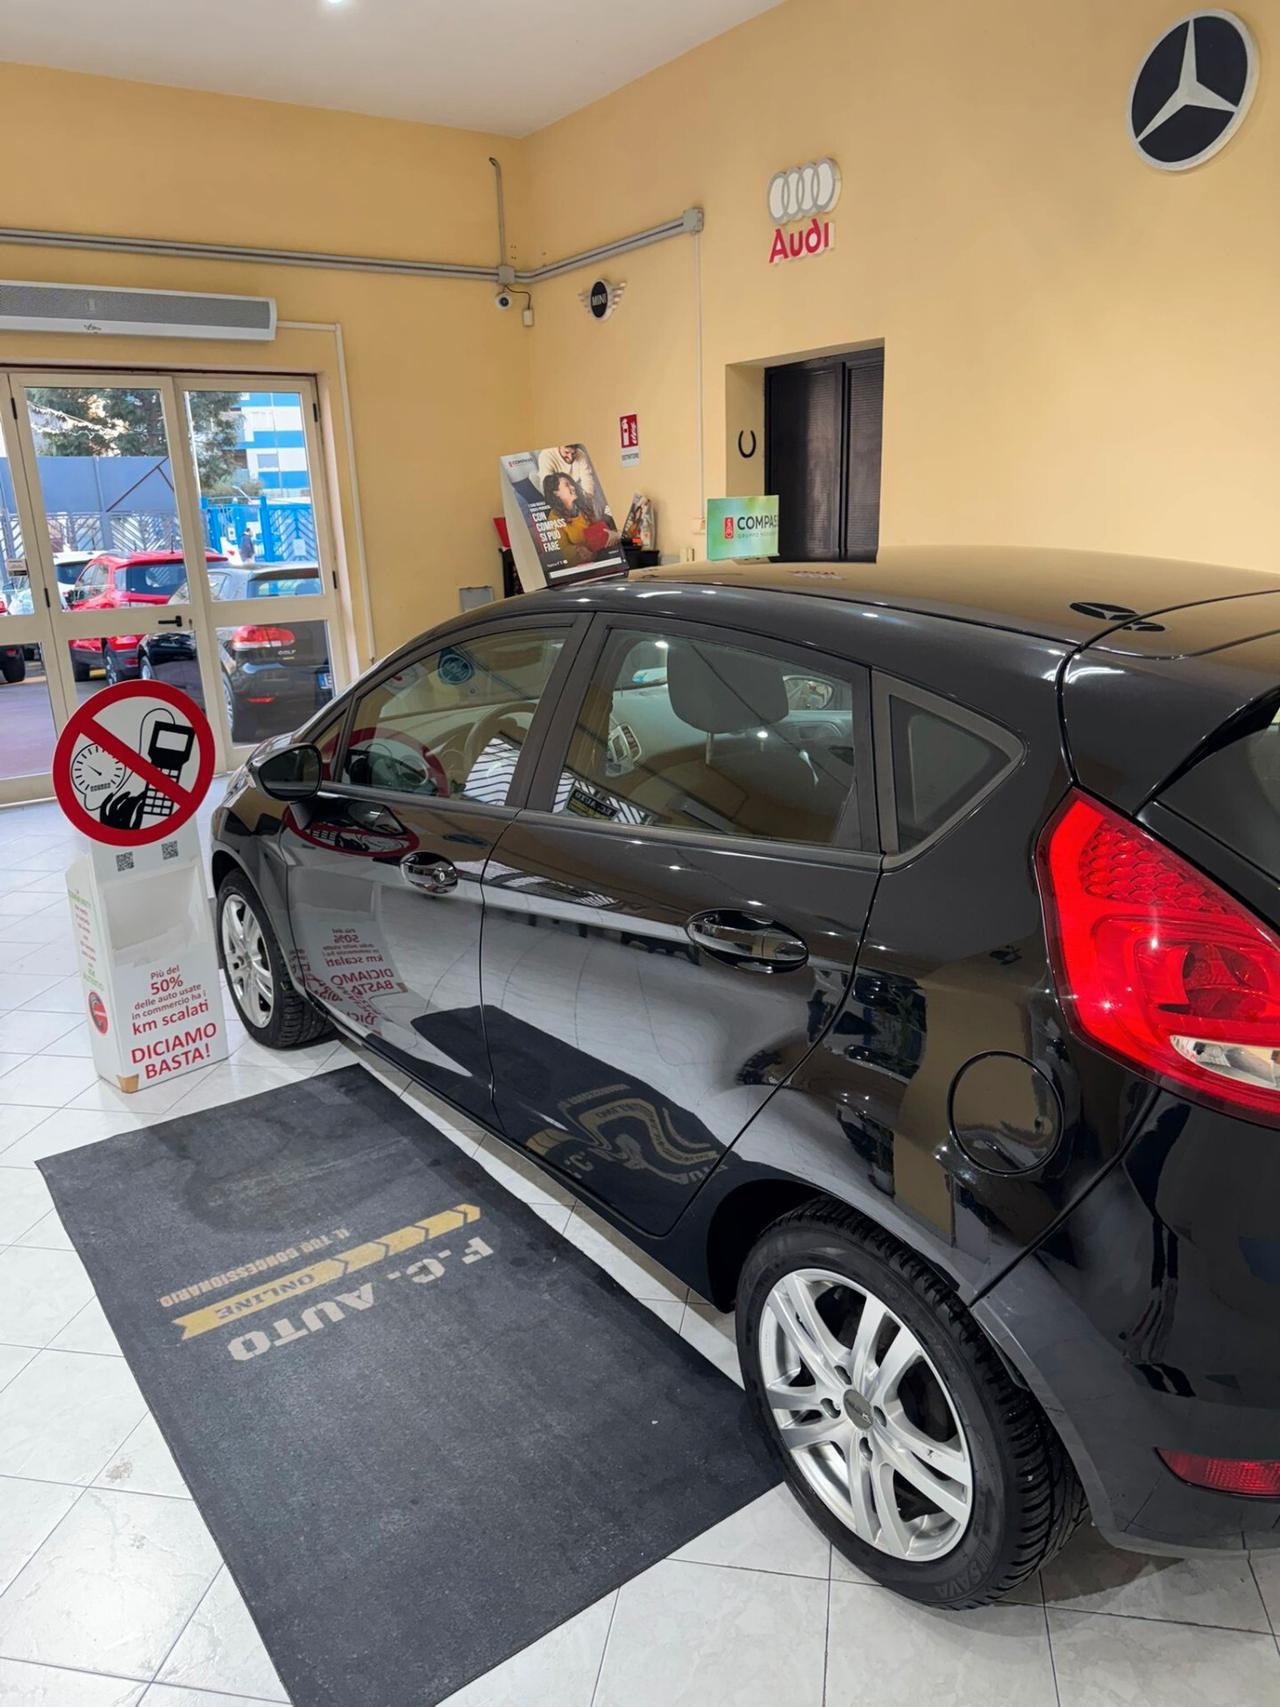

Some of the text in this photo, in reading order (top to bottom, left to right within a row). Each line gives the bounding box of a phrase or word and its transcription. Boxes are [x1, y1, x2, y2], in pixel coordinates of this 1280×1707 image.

[768, 218, 830, 263] Audi
[532, 511, 547, 522] CON
[536, 518, 567, 532] COMPASS
[539, 532, 548, 542] SI
[150, 964, 180, 980] Più del
[151, 974, 183, 995] 50%
[132, 1012, 140, 1020] in
[143, 996, 190, 1017] commercio
[191, 993, 201, 1001] ha
[134, 984, 201, 1010] delle auto usate
[132, 999, 209, 1036] km scalati
[131, 1022, 217, 1064] DICIAMO
[145, 1043, 210, 1079] BASTA!
[299, 1234, 333, 1255] TUO
[214, 1274, 315, 1320] ONLINE
[227, 1237, 494, 1361] F.C. AUTO
